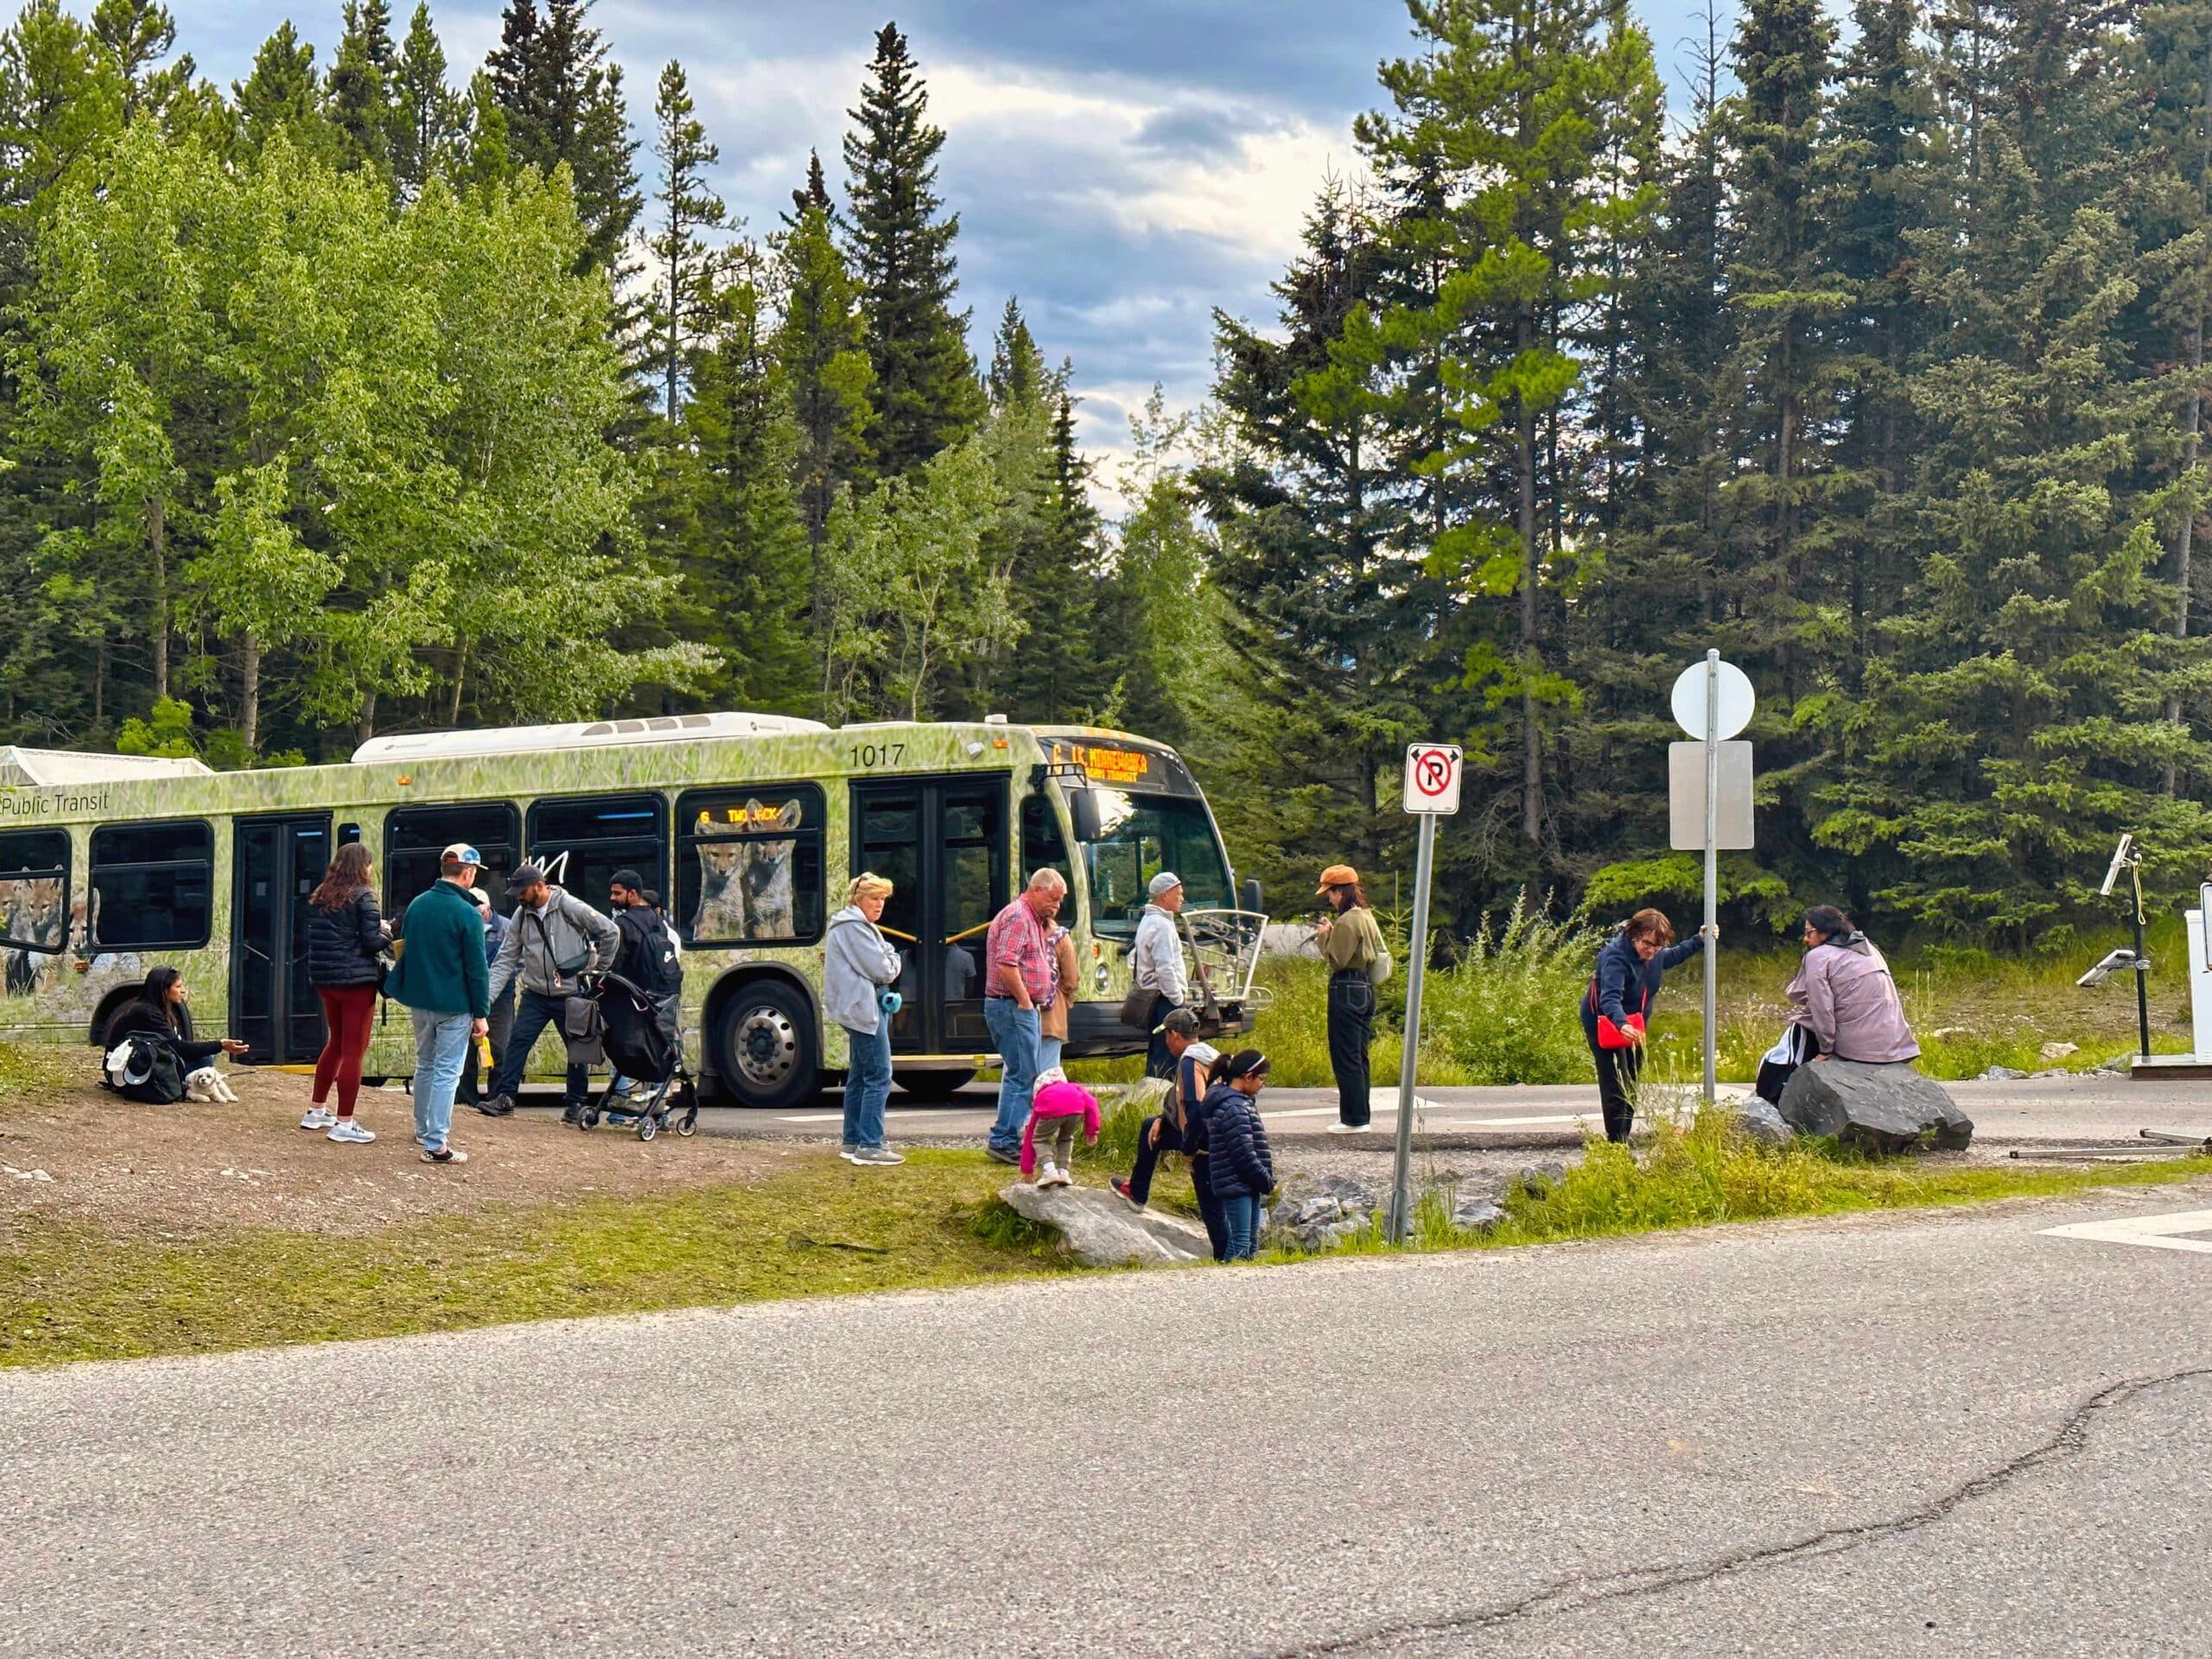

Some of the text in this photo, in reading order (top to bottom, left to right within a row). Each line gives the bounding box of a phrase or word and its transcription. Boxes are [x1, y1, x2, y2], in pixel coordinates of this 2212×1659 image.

[850, 744, 905, 767] 1017
[1427, 762, 1443, 785] P
[2, 791, 109, 816] Public Transit
[700, 811, 709, 824] 6
[728, 810, 747, 823] TWO
